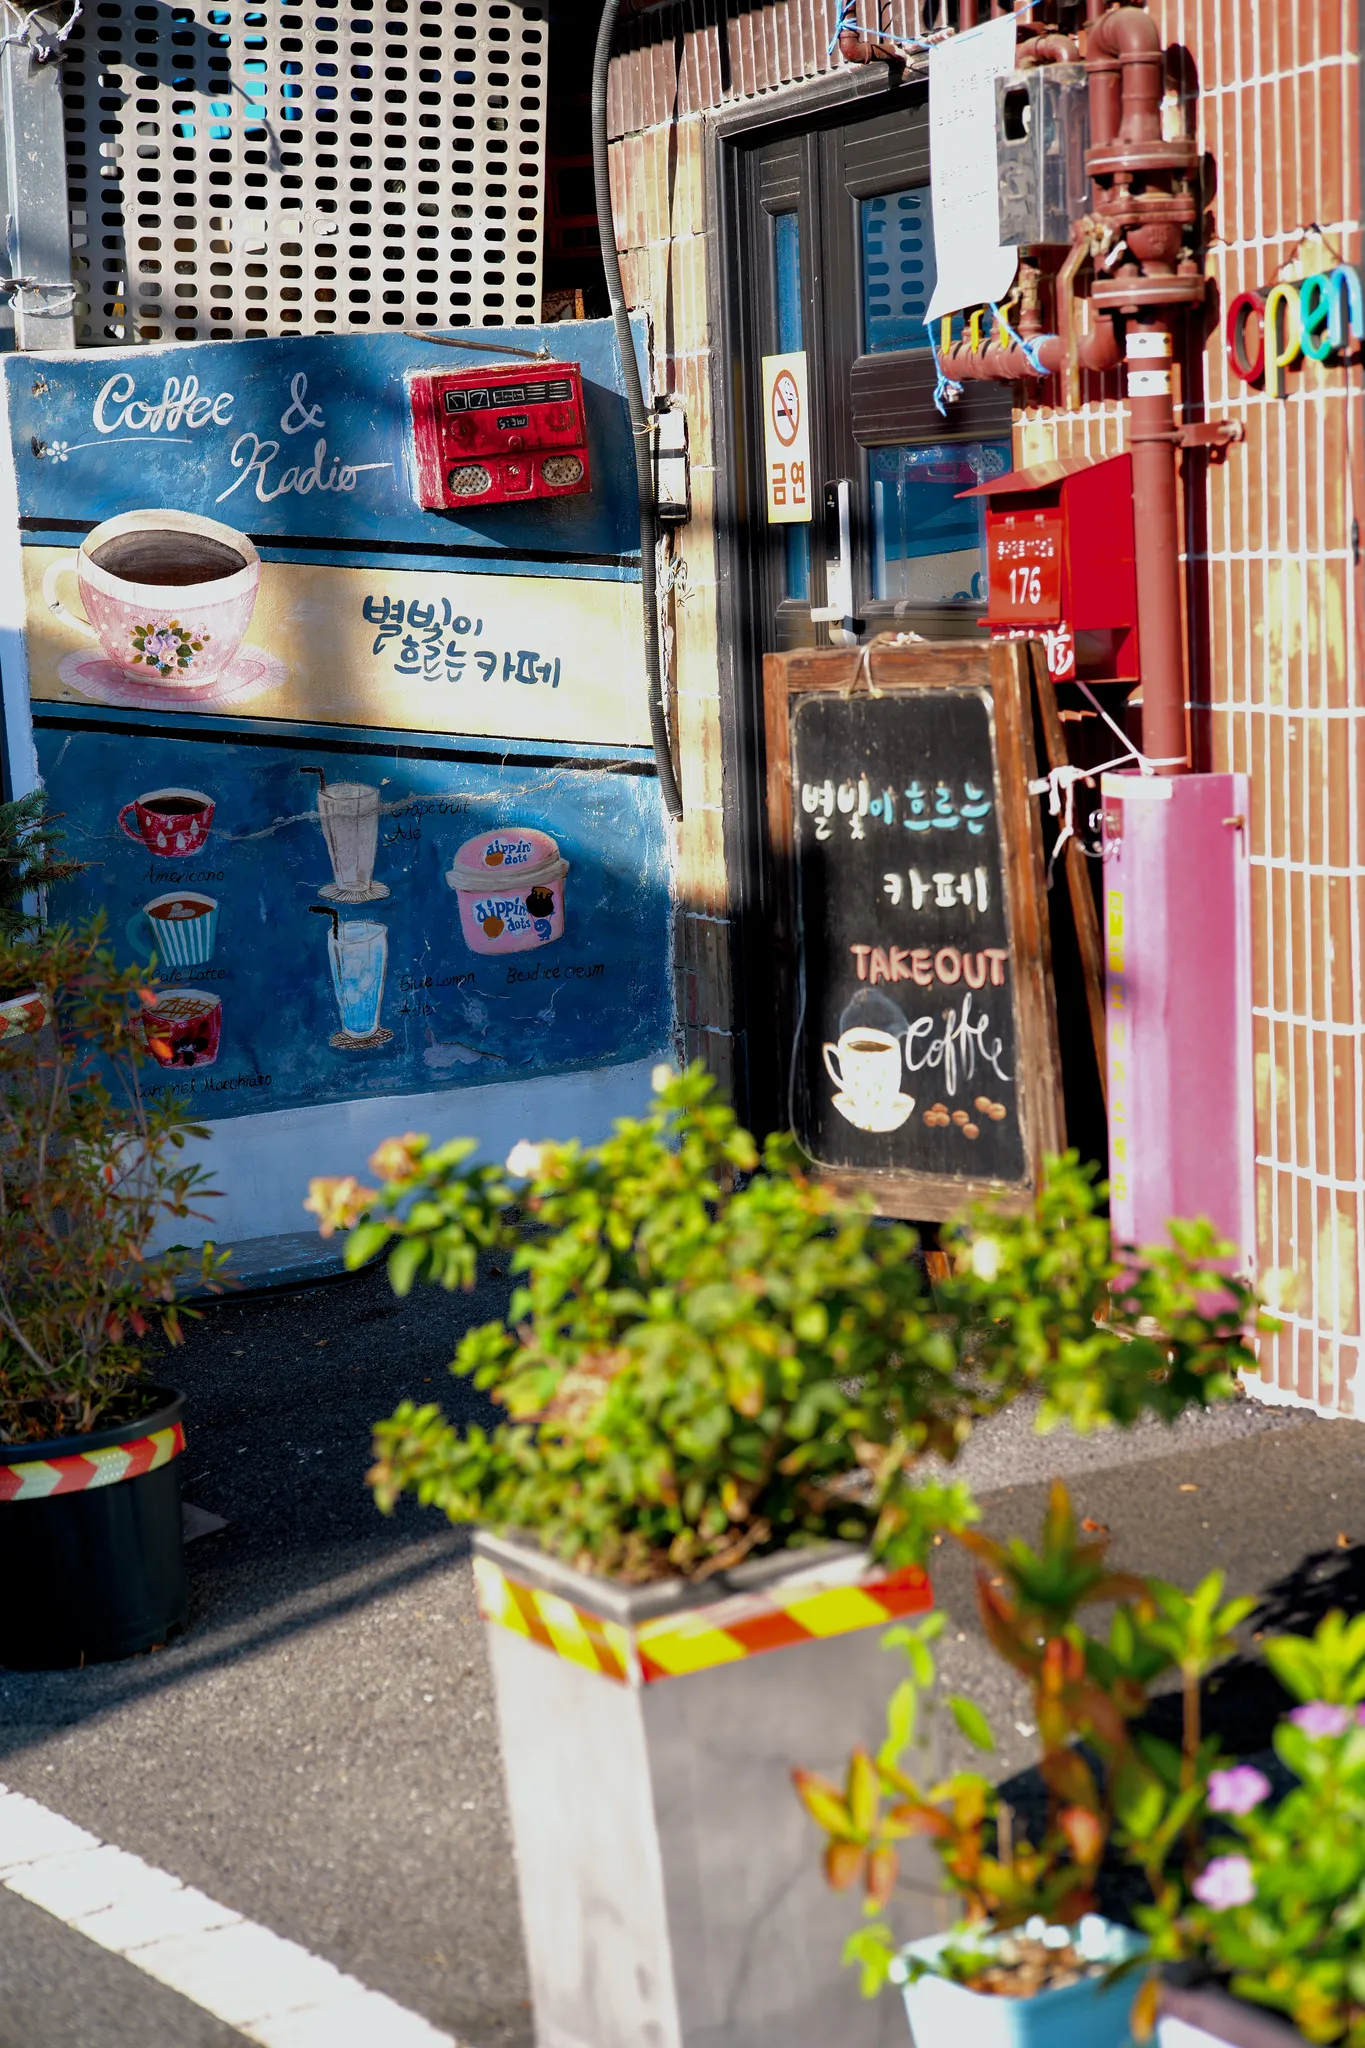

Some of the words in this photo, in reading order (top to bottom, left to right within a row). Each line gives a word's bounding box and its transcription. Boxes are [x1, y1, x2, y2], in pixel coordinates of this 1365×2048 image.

[1226, 266, 1363, 399] open
[93, 373, 234, 433] Coffee
[280, 371, 325, 434] &
[215, 432, 394, 503] Radio
[771, 460, 806, 505] 금연
[1009, 566, 1041, 604] 176
[362, 595, 483, 655] 별빛이
[394, 634, 467, 682] 흐르는
[473, 650, 561, 688] 카페
[802, 779, 893, 840] 별빛이
[903, 780, 992, 834] 흐르는
[142, 865, 225, 884] Americano
[504, 853, 528, 865] dots
[883, 867, 988, 912] 카페
[506, 917, 531, 932] dots
[188, 966, 227, 981] Latte
[400, 974, 433, 991] Blue
[436, 972, 477, 987] Lemon
[507, 962, 540, 984] Bead
[543, 966, 561, 980] ice
[850, 944, 1008, 989] TAKEOUT
[201, 1072, 273, 1092] Macchiato
